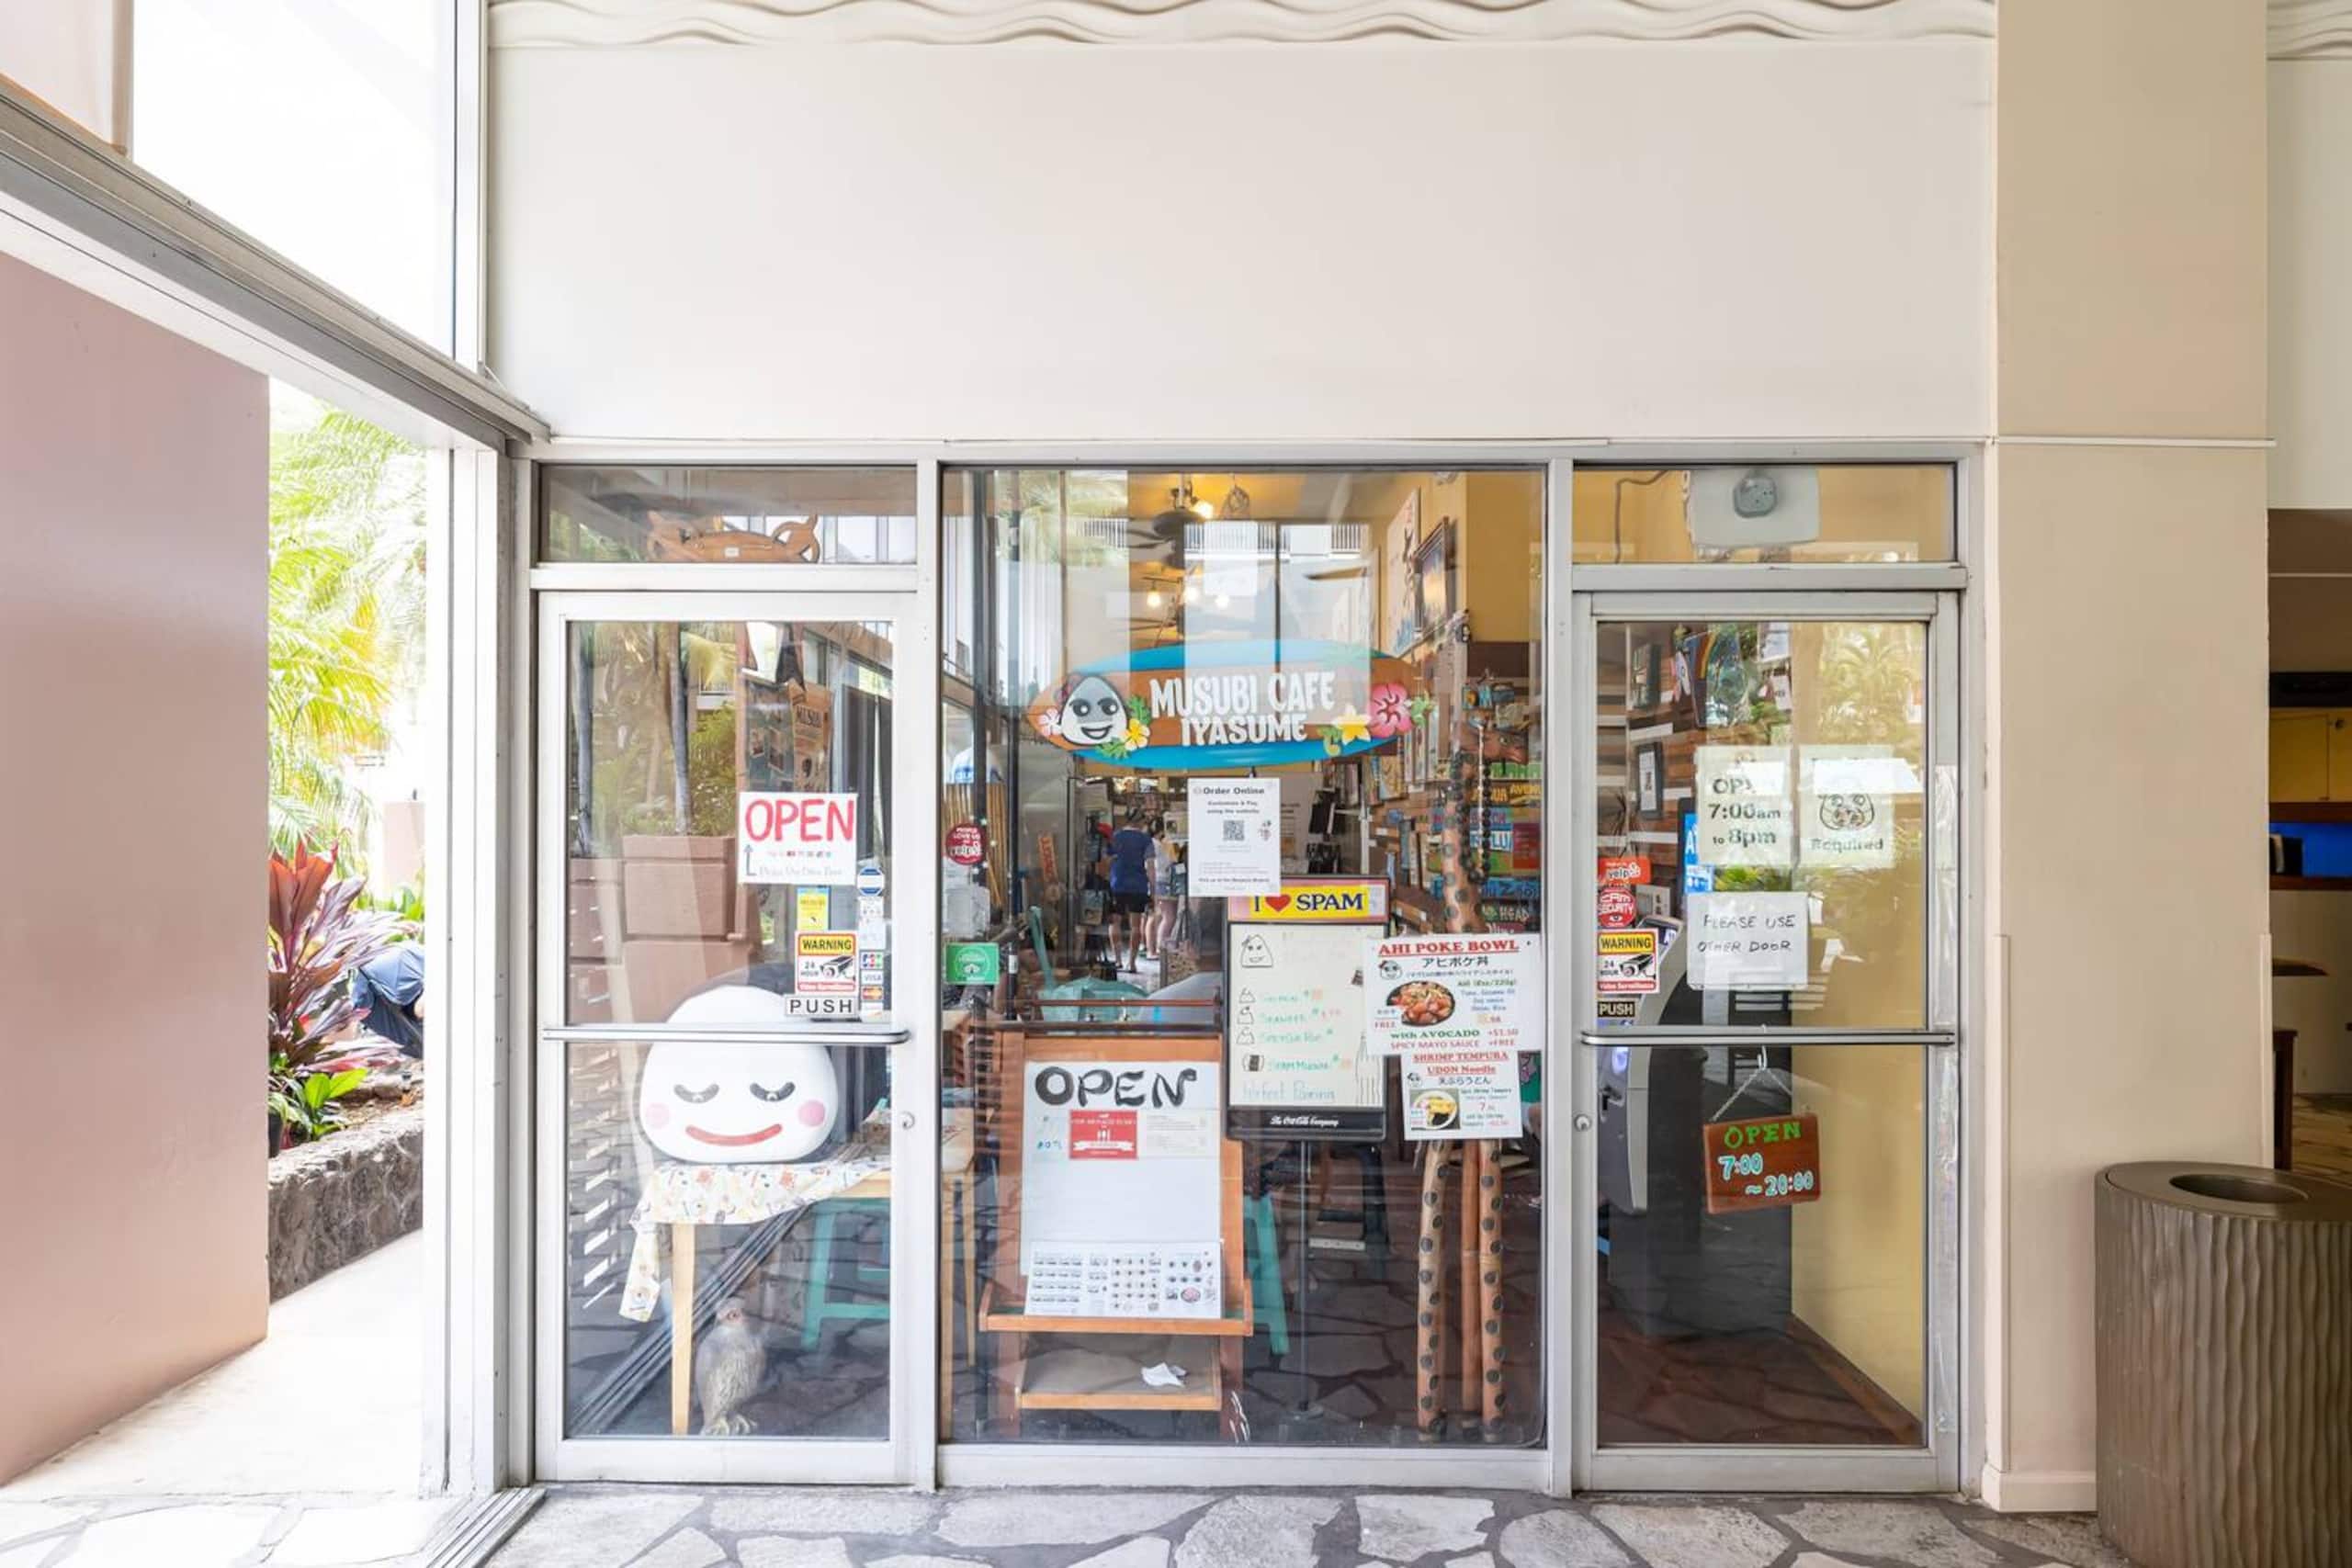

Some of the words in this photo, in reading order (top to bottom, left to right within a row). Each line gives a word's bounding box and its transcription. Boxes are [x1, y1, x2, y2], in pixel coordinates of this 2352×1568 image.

[1149, 673, 1258, 718] MUSUBI
[1268, 671, 1336, 712] CAFE
[1181, 712, 1308, 746] IYASUME
[1203, 786, 1231, 795] Order
[1233, 786, 1265, 795] Online
[1708, 803, 1781, 819] 7:00am
[744, 797, 855, 842] OPEN
[1712, 834, 1724, 845] to
[1728, 829, 1777, 848] 8pm
[1811, 837, 1883, 853] Required
[1254, 896, 1261, 912] I
[1295, 893, 1363, 911] SPAM
[1598, 902, 1634, 915] SECURITY
[1703, 914, 1757, 929] PLEASE
[1765, 914, 1796, 929] USE
[802, 939, 853, 951] WARNING
[1378, 943, 1410, 955] AHI
[1416, 942, 1464, 953] POKE
[1468, 940, 1520, 953] BOWL
[1600, 938, 1652, 949] WARNING
[1697, 941, 1741, 953] OTHER
[1748, 940, 1792, 953] DOOR
[1603, 960, 1614, 968] 24
[789, 998, 853, 1014] PUSH
[1599, 1002, 1634, 1015] PUSH
[1390, 1030, 1417, 1039] with
[1419, 1029, 1480, 1038] AVOCADO
[1390, 1042, 1417, 1050] SPICY
[1413, 1053, 1455, 1062] SHRIMP
[1457, 1051, 1510, 1060] TEMPURA
[1427, 1066, 1459, 1075] UDON
[1461, 1066, 1496, 1074] Noodle
[1035, 1066, 1198, 1109] OPEN
[1439, 1077, 1491, 1085] 天ぷらうどん
[1270, 1115, 1282, 1125] The
[1309, 1115, 1339, 1127] Company
[1724, 1122, 1803, 1149] OPEN
[1717, 1152, 1764, 1180] 7:00
